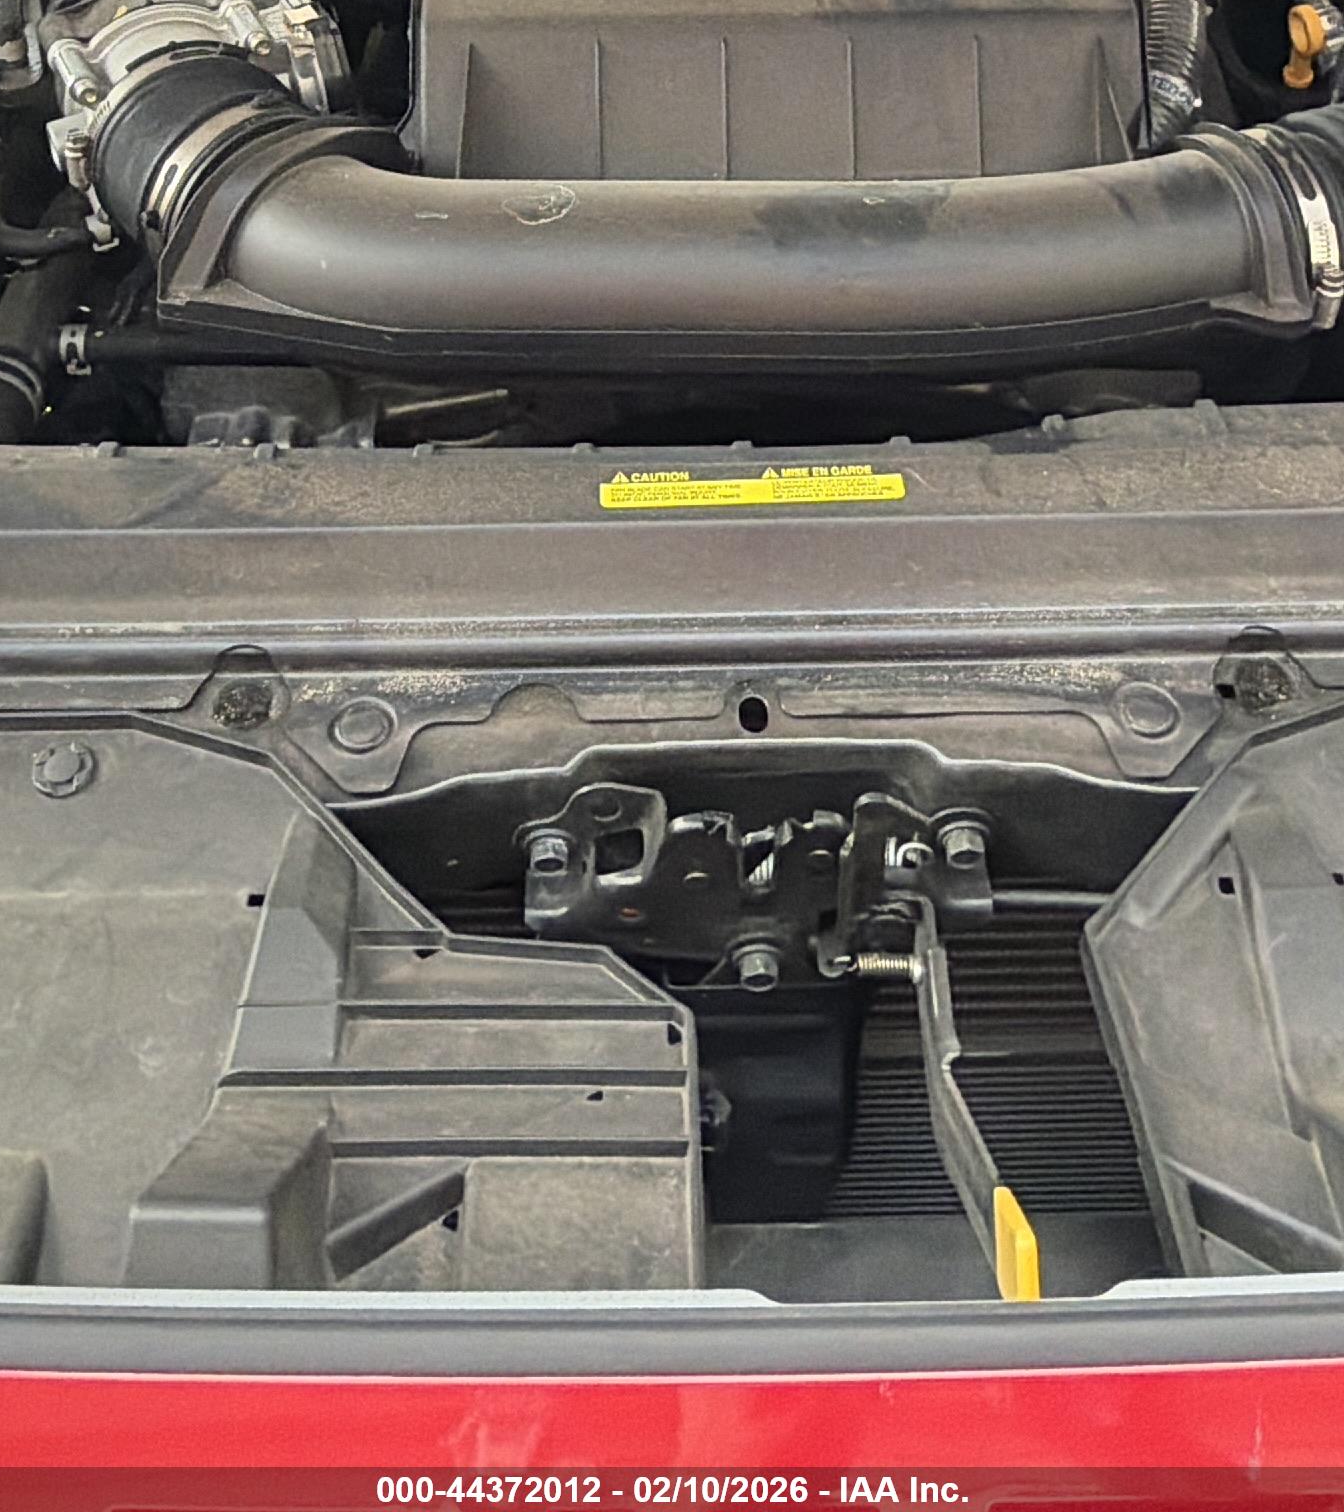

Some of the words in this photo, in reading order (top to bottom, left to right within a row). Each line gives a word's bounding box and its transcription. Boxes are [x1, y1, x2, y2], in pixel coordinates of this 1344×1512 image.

[631, 471, 690, 483] CAUTION
[781, 467, 809, 478] MISE
[812, 466, 829, 477] EN
[830, 464, 872, 476] GARDE
